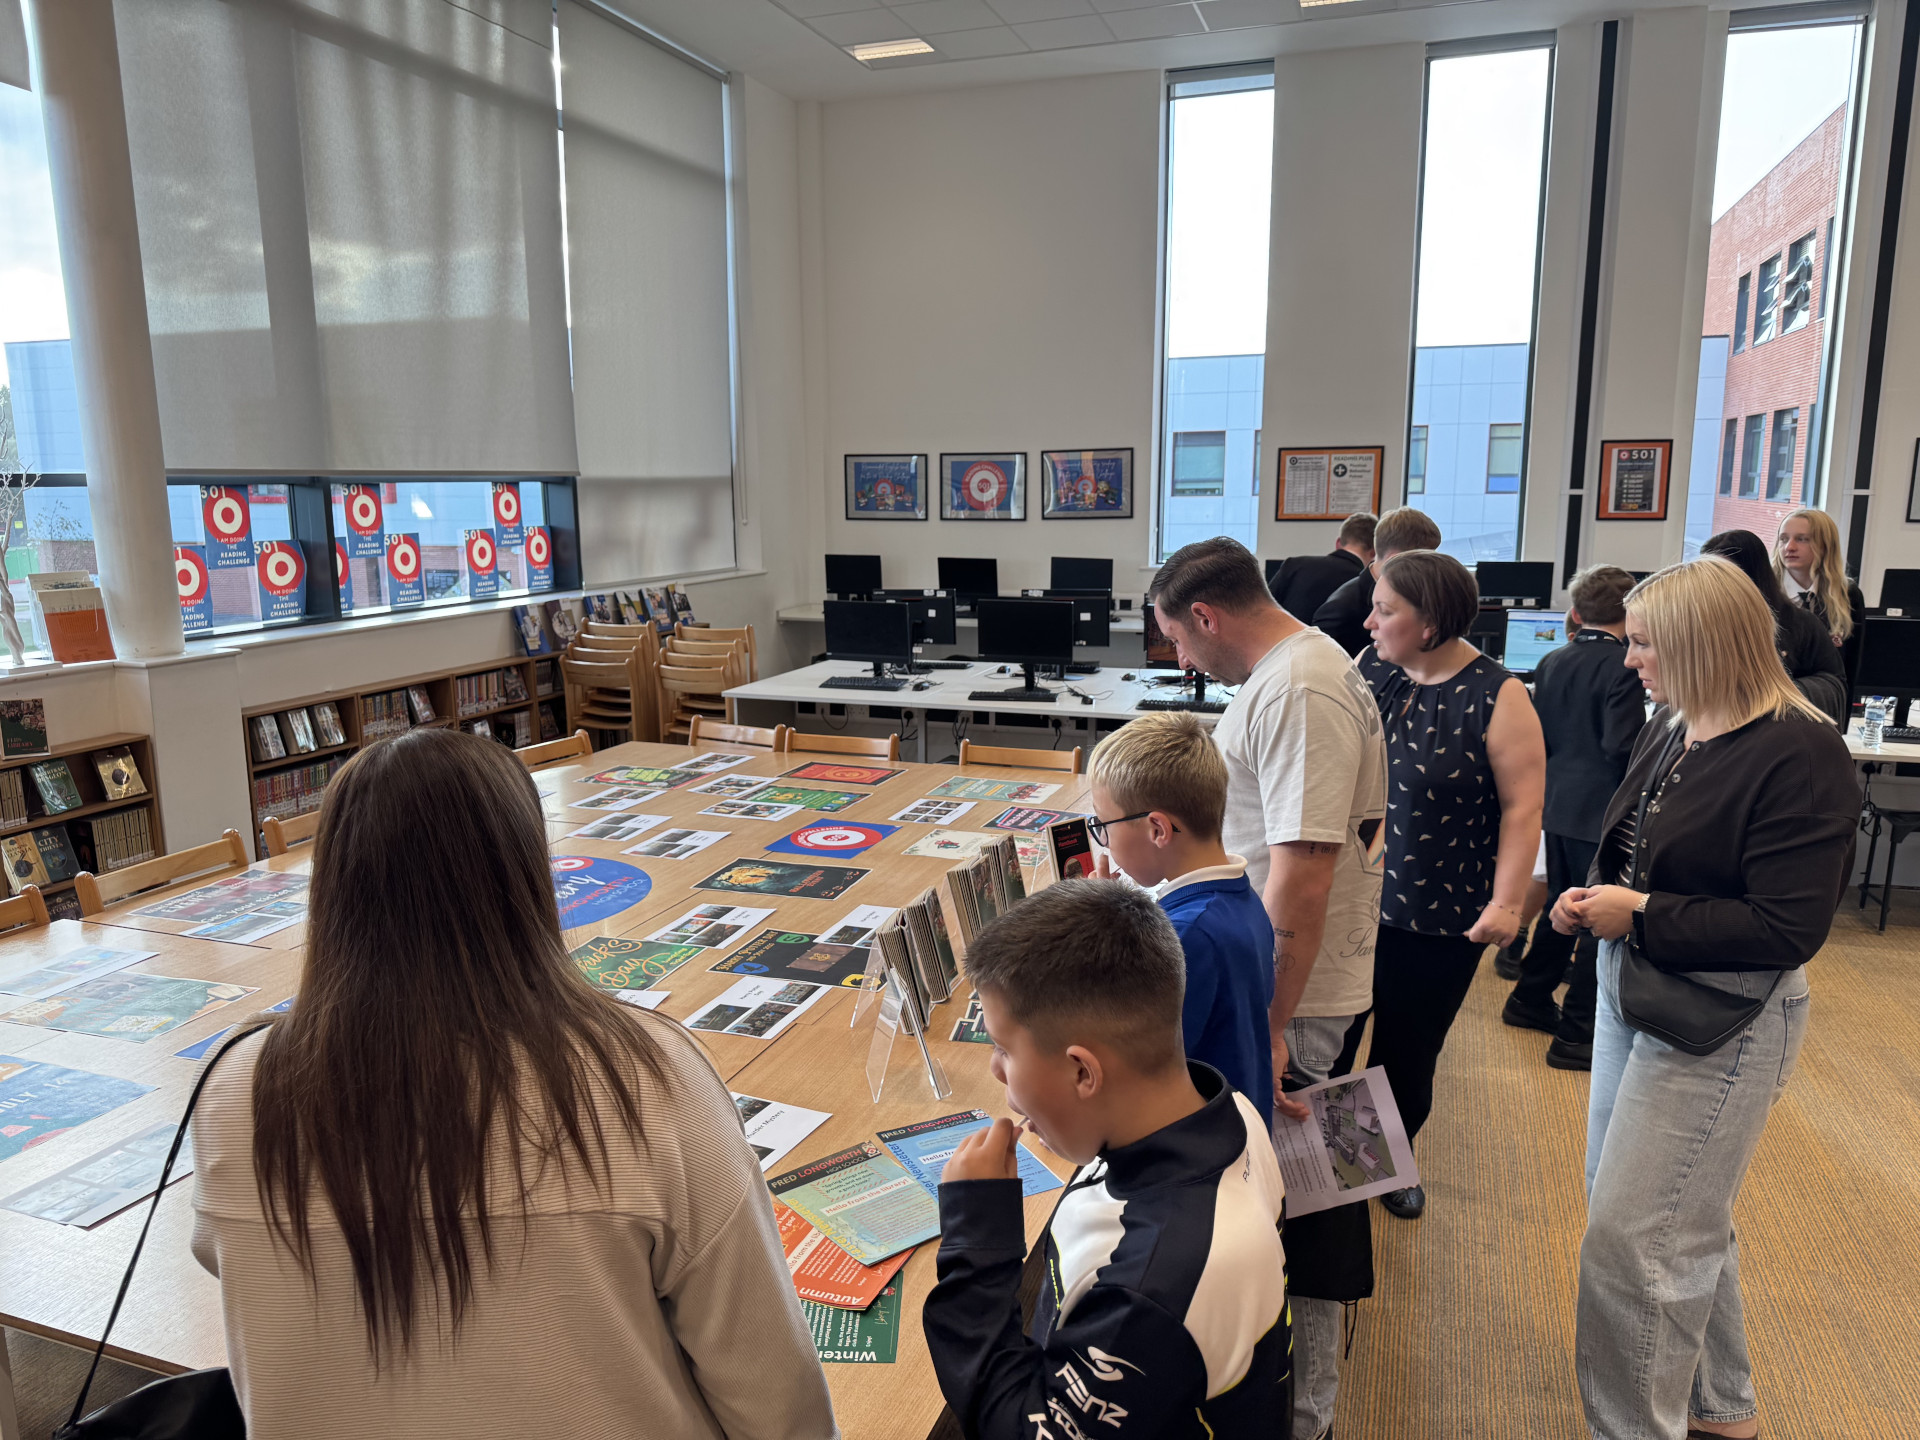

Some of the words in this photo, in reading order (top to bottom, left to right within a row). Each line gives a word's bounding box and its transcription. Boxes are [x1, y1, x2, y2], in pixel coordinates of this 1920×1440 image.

[1632, 450, 1654, 459] 501
[200, 486, 226, 498] 501
[342, 484, 363, 495] 501
[384, 534, 404, 545] 501
[464, 530, 480, 540] 501
[523, 526, 538, 537] 501
[254, 541, 278, 554] 501
[218, 558, 250, 566] CHALLENGE
[270, 609, 302, 617] CHALLENGE
[273, 602, 298, 610] READING
[38, 836, 59, 847] CITY
[559, 876, 634, 914] NGWORTH
[225, 902, 256, 918] your
[716, 950, 744, 971] HARRY
[741, 936, 767, 957] POTTER
[599, 953, 671, 988] Day
[0, 1091, 38, 1113] ULY
[763, 1109, 785, 1127] Mystery
[907, 1113, 971, 1133] LONGWORTH
[826, 1163, 842, 1174] HIGH
[841, 1155, 867, 1168] SCHOOL
[887, 1143, 927, 1181] Newsletter
[922, 1153, 944, 1163] Hello
[771, 1174, 798, 1189] FRED
[798, 1149, 863, 1178] LONGWORTH
[825, 1201, 848, 1214] Hello
[847, 1194, 866, 1207] from
[865, 1189, 881, 1200] the
[880, 1178, 910, 1195] library!
[787, 1198, 837, 1236] Newsletter
[796, 1245, 807, 1260] from
[804, 1237, 816, 1250] the
[832, 1234, 867, 1259] Easter
[799, 1286, 865, 1305] Autumn
